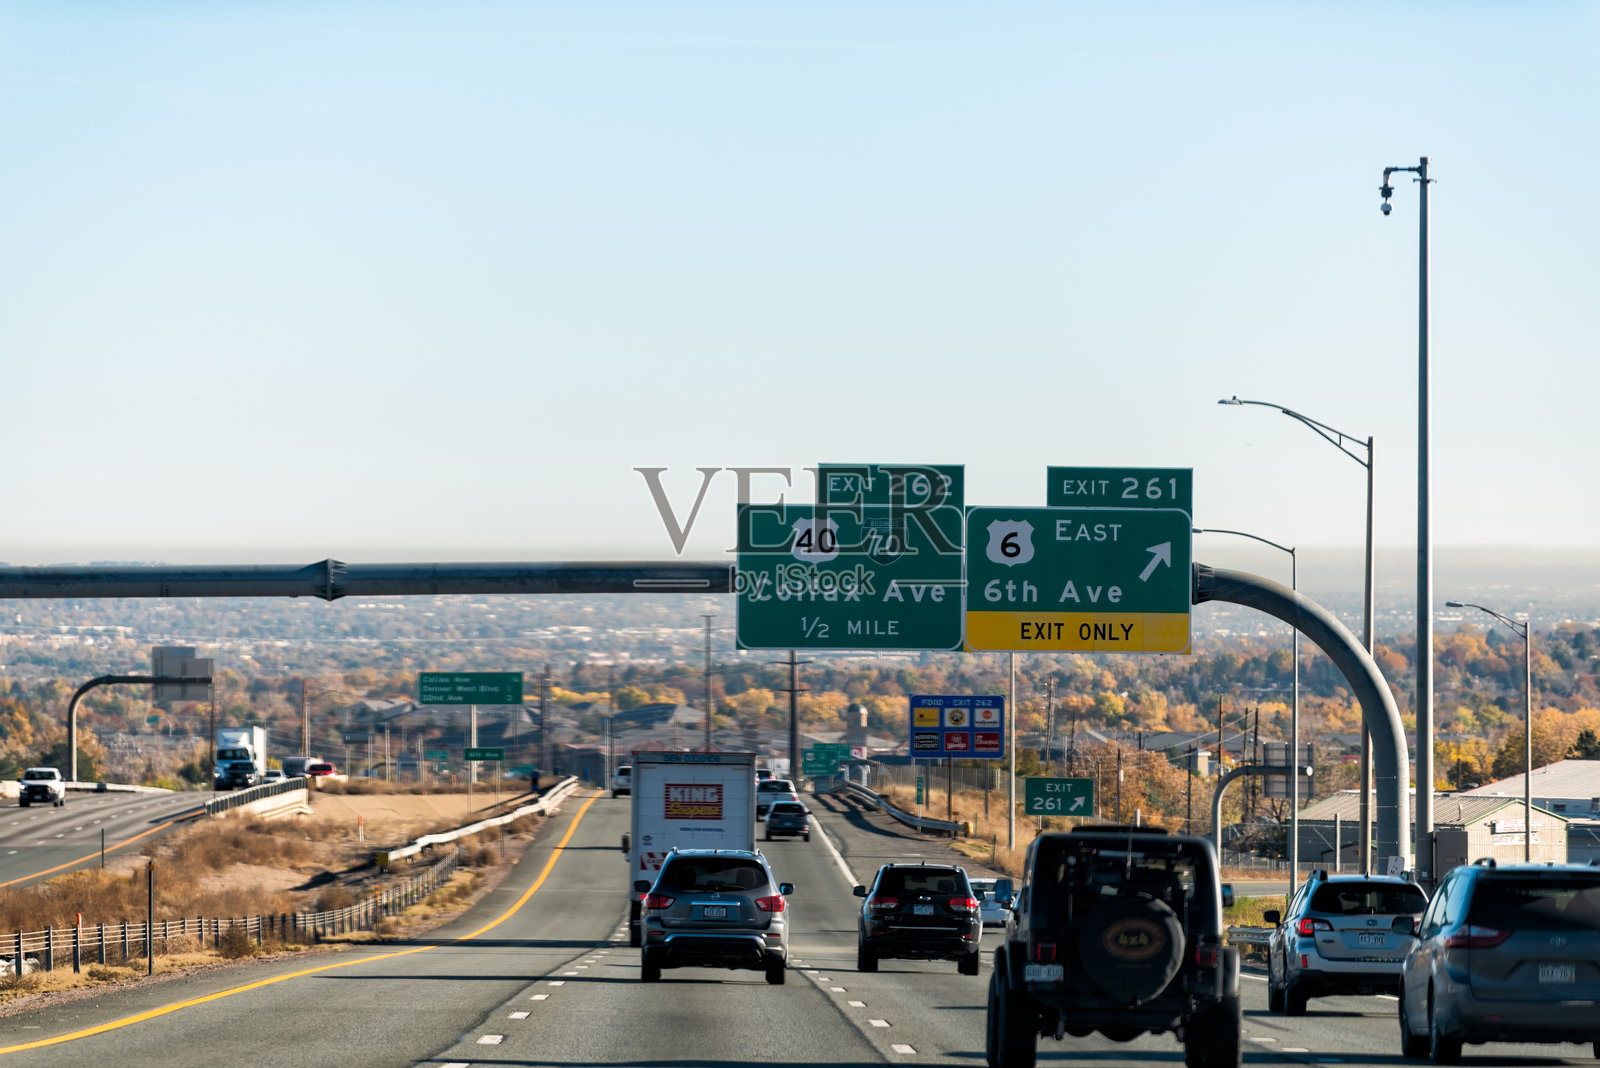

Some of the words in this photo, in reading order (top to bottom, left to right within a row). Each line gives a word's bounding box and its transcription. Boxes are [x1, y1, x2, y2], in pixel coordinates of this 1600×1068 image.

[830, 477, 876, 491] EXIT
[888, 474, 953, 496] 262
[1063, 480, 1110, 495] EXIT
[1121, 477, 1177, 499] 261
[796, 528, 837, 553] 40
[1055, 520, 1122, 541] EAST
[869, 534, 901, 556] 70
[1000, 531, 1021, 558] 6
[882, 580, 946, 602] Ave
[984, 579, 1038, 602] 6th
[1059, 580, 1122, 602] Ave
[847, 620, 899, 635] MILE
[1020, 622, 1064, 640] EXIT
[1079, 623, 1134, 641] ONLY
[668, 786, 720, 803] KING
[1046, 783, 1073, 793] EXIT
[1033, 797, 1062, 810] 261
